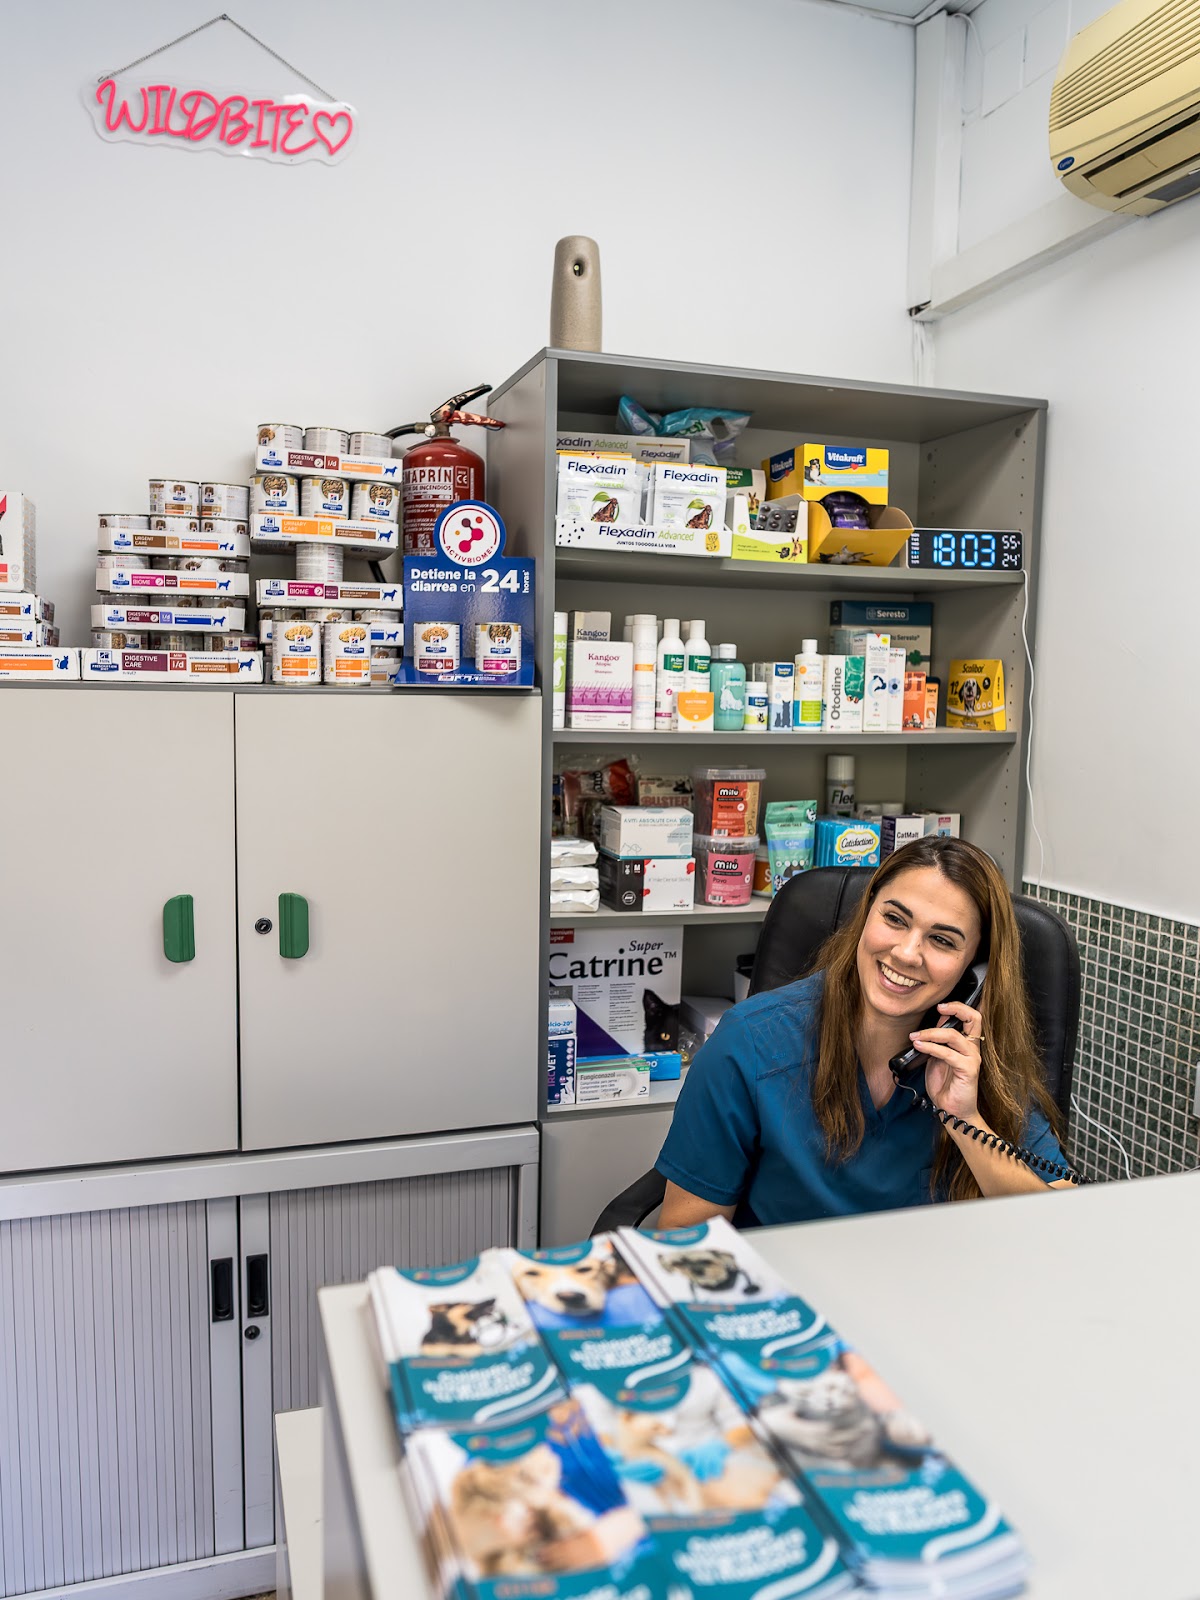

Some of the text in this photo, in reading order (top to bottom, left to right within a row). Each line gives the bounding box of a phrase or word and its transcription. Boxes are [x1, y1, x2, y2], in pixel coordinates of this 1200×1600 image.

[96, 80, 317, 154] WILDBITE
[595, 441, 628, 450] Advanced
[290, 453, 314, 462] DIGESTIVE
[641, 449, 681, 459] Flexadin
[827, 451, 863, 463] Vitakraft
[568, 461, 627, 475] Flexadin
[664, 469, 718, 483] Flexadin
[599, 526, 695, 542] Flexadin Advanced
[411, 569, 476, 580] Detiene la
[411, 581, 457, 592] diarrea
[460, 583, 476, 592] en
[480, 569, 521, 593] 24
[877, 609, 906, 619] Seresto
[577, 629, 608, 638] Kangoo
[588, 653, 620, 662] Kangoo
[962, 664, 984, 674] Scalibor
[831, 667, 842, 720] Otodine
[841, 837, 874, 849] Catisfactions
[629, 940, 664, 954] Super
[580, 1072, 616, 1081] Fungiconazol
